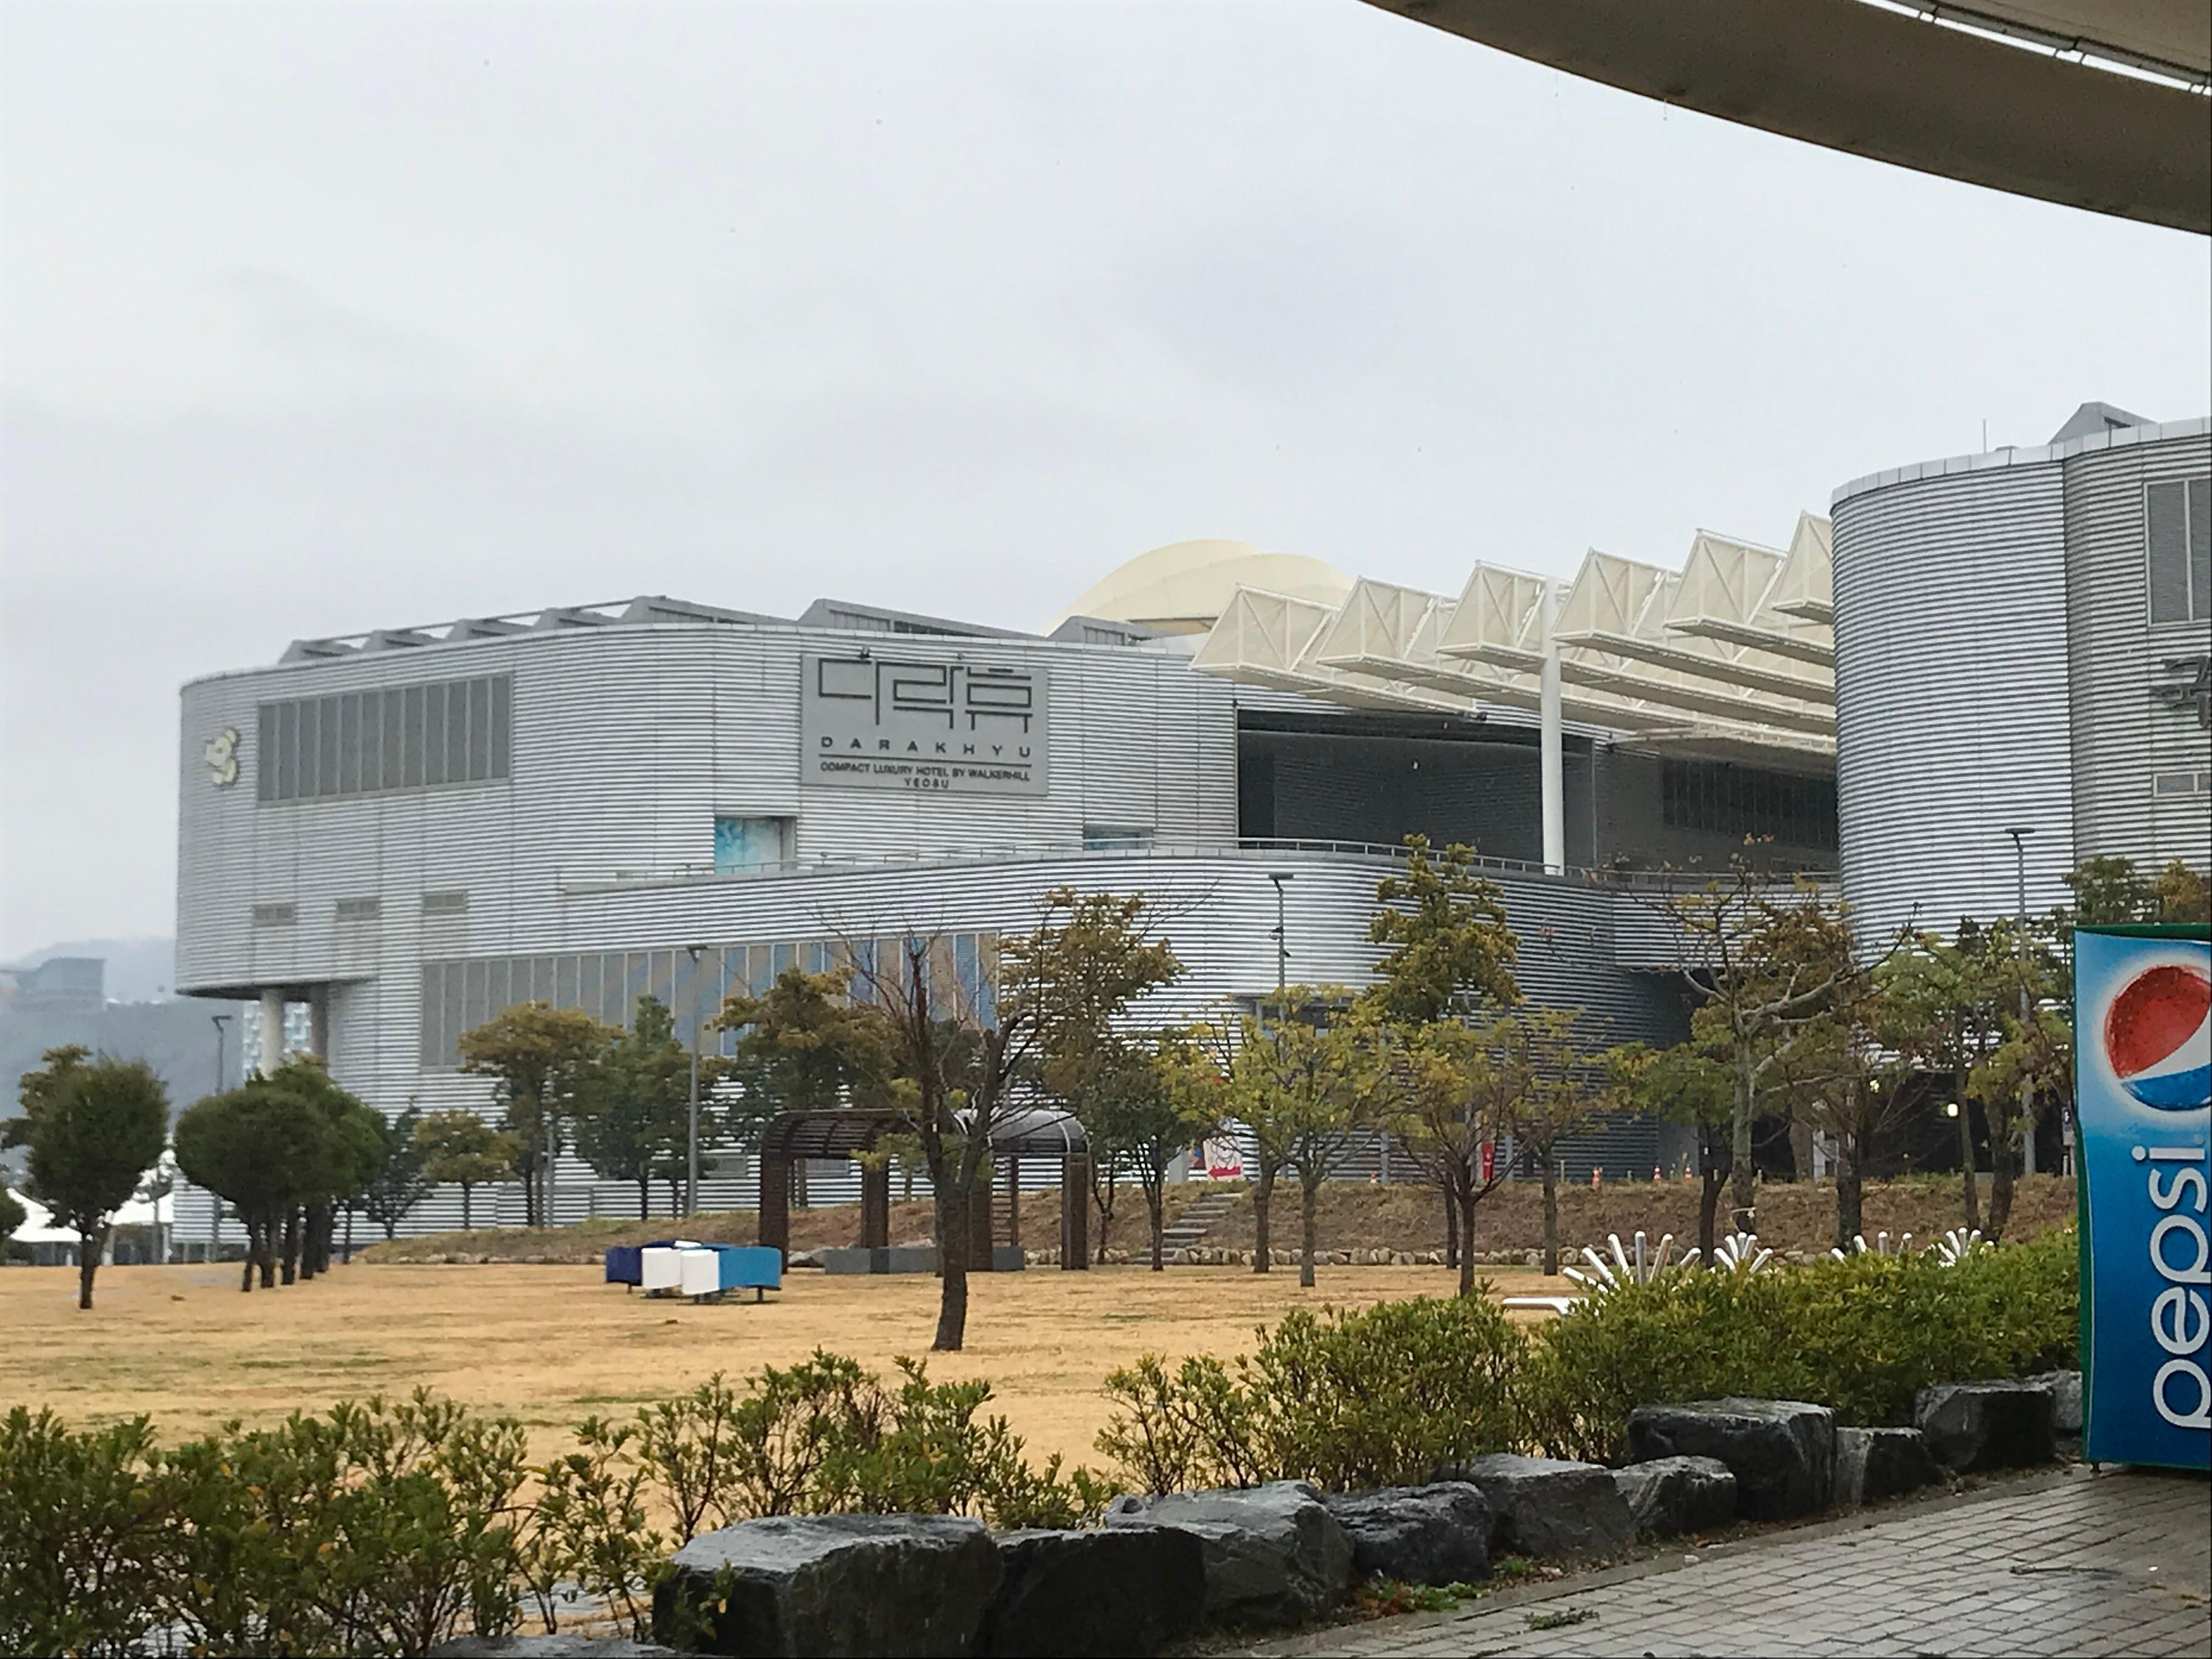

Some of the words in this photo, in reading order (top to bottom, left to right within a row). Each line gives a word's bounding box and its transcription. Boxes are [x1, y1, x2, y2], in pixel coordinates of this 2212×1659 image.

[821, 736, 1031, 758] DARAKHYU
[820, 761, 870, 773] COMPACT
[873, 764, 913, 775] LUXURY
[915, 766, 949, 777] HOTEL
[952, 768, 966, 777] BY
[967, 769, 1030, 782] WALKERHILL
[904, 777, 949, 789] YEOSU
[2131, 1145, 2211, 1429] pepsi
